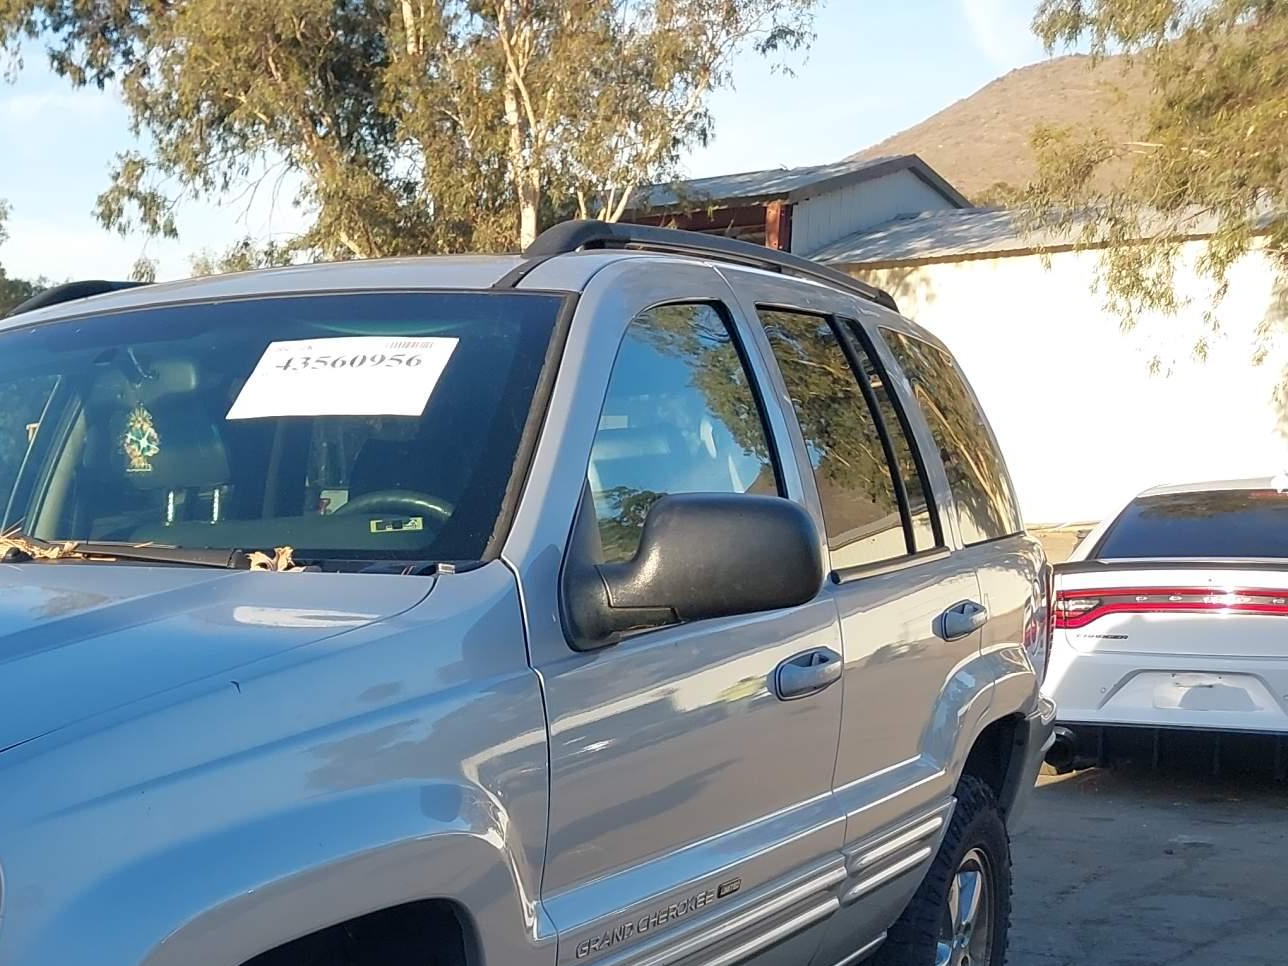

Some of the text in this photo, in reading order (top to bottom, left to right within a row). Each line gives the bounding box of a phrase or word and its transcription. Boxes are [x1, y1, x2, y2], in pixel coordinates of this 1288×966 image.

[274, 353, 423, 371] 43560956
[575, 922, 634, 959] GRAND
[637, 888, 715, 934] CHEROKEE
